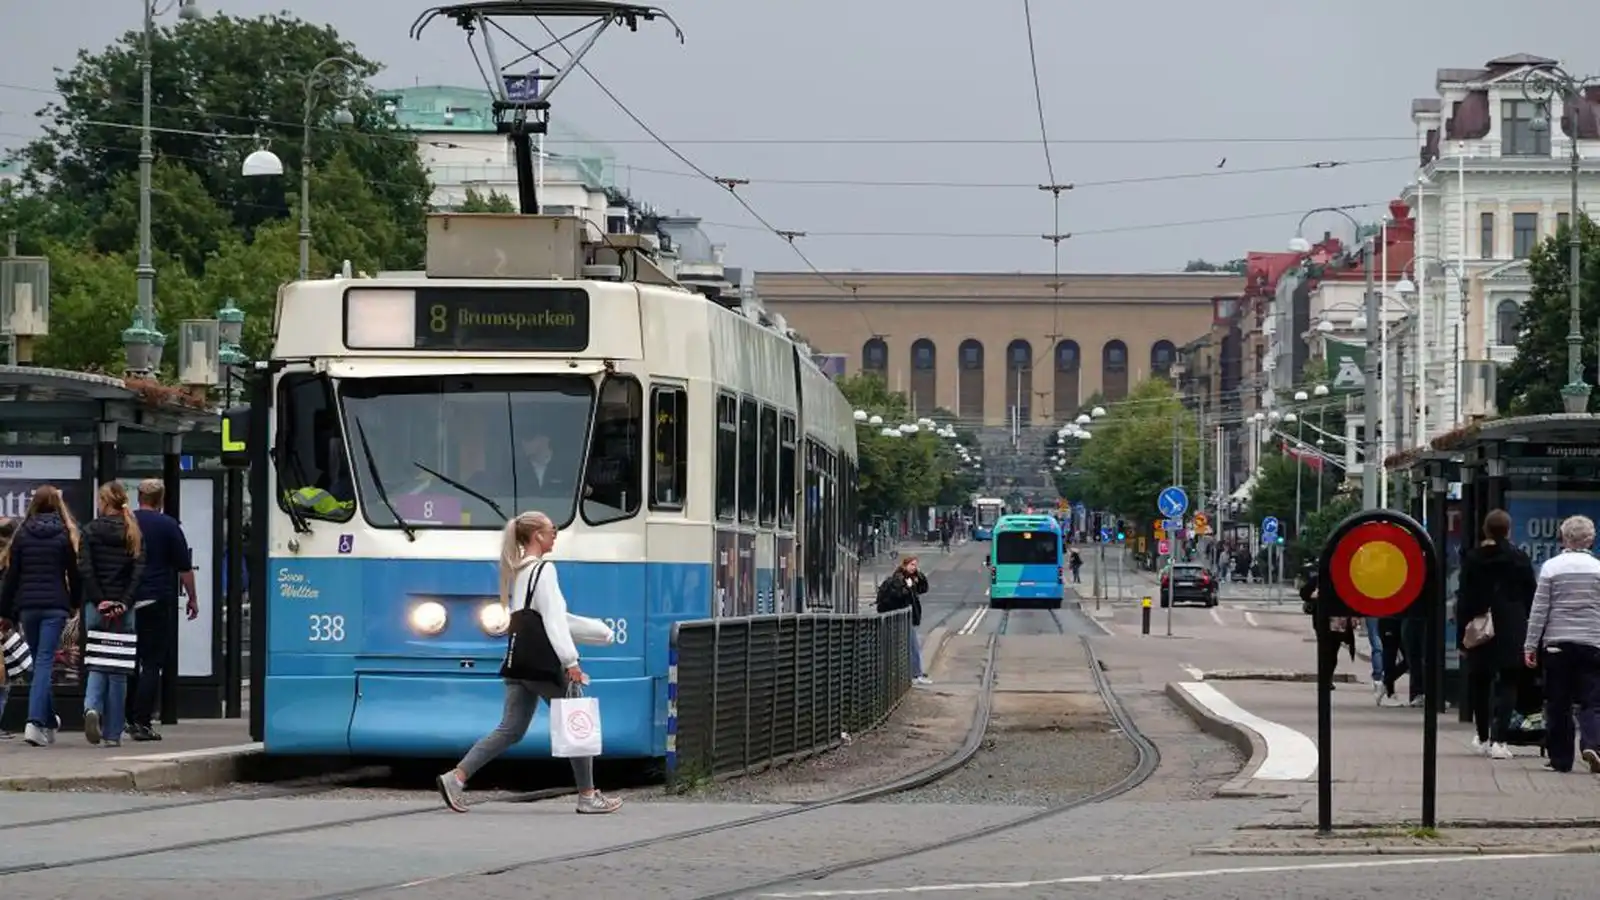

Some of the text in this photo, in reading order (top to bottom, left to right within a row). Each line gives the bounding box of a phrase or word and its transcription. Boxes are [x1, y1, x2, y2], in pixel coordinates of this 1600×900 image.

[430, 304, 576, 332] 8 Brunnsparken
[423, 500, 434, 519] 8
[309, 615, 345, 641] 338
